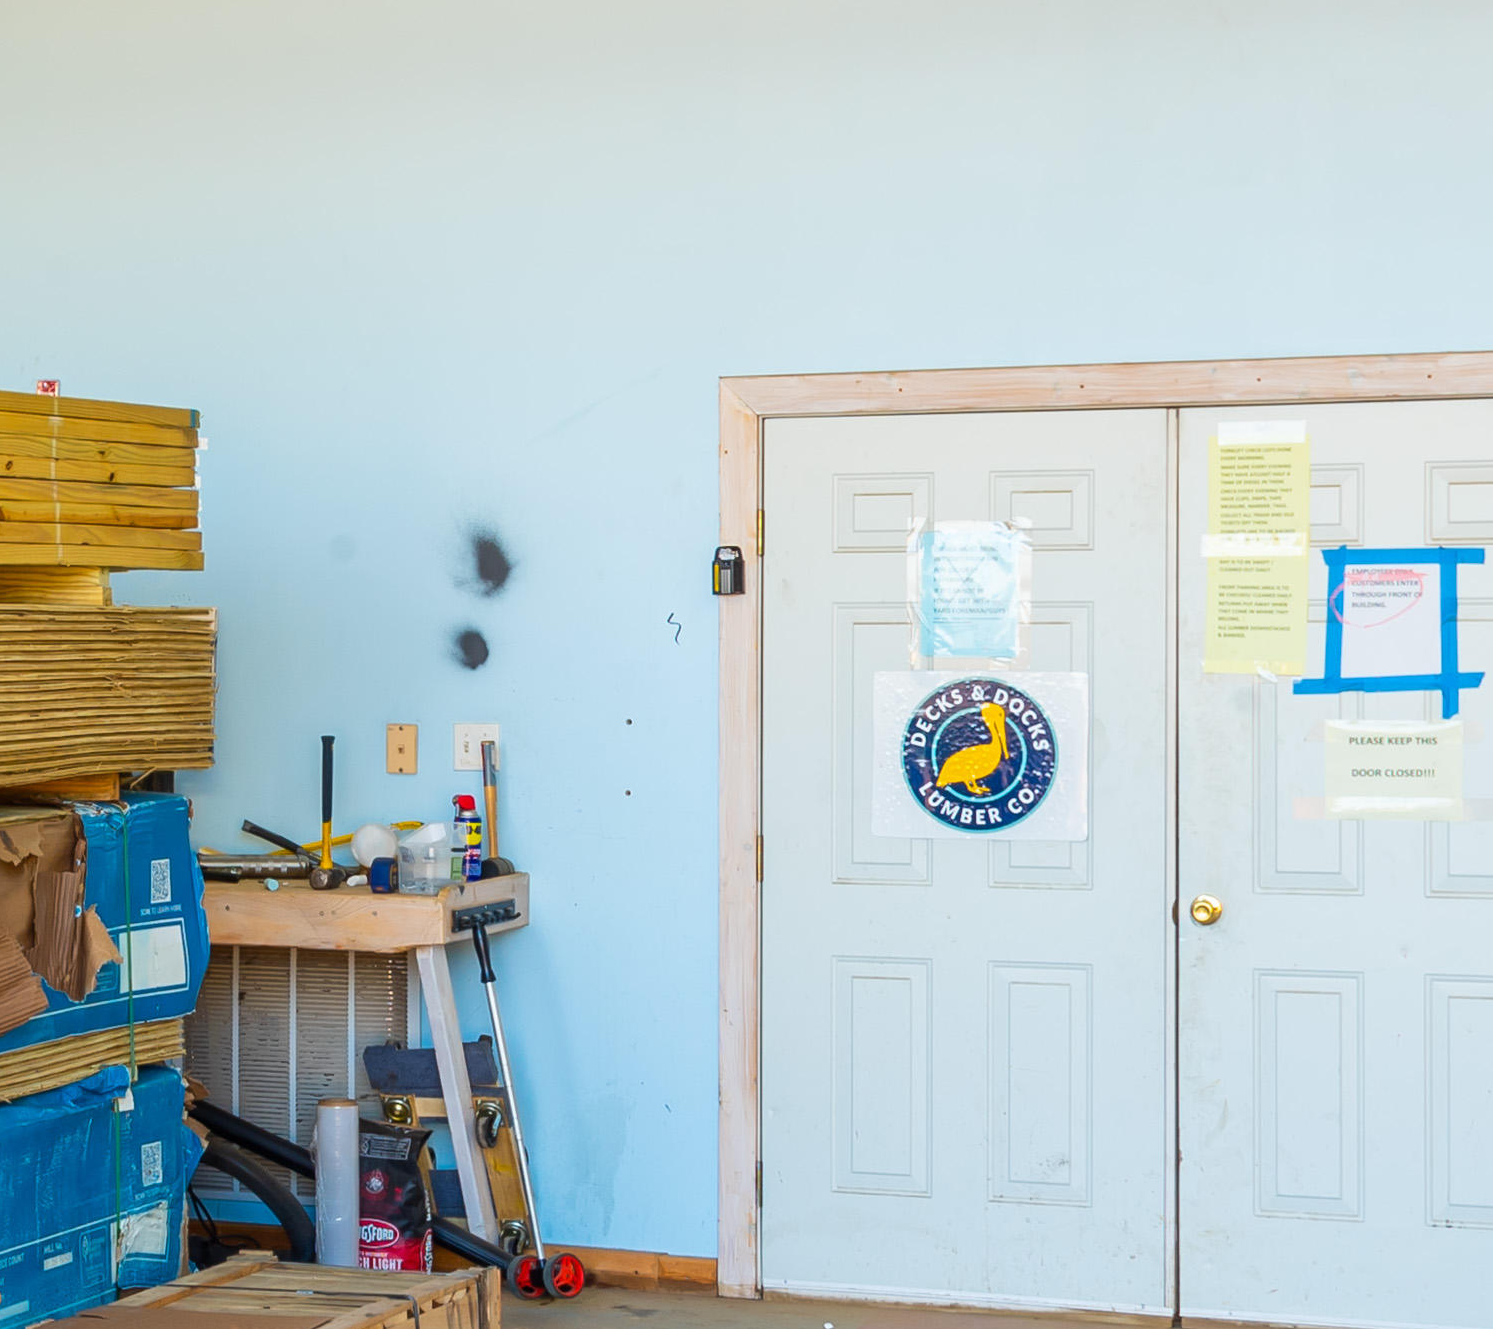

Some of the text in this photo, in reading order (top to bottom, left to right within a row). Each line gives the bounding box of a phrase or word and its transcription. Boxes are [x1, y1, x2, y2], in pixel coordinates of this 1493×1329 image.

[910, 685, 1049, 751] DECKS & DOCKS
[1349, 737, 1438, 745] PLEASE KEEP THIS
[1351, 769, 1435, 777] DOOR CLOSED!!!
[918, 781, 1039, 825] LUMBER CO.
[360, 1224, 394, 1243] GSFORD
[373, 1258, 403, 1271] LIGHT
